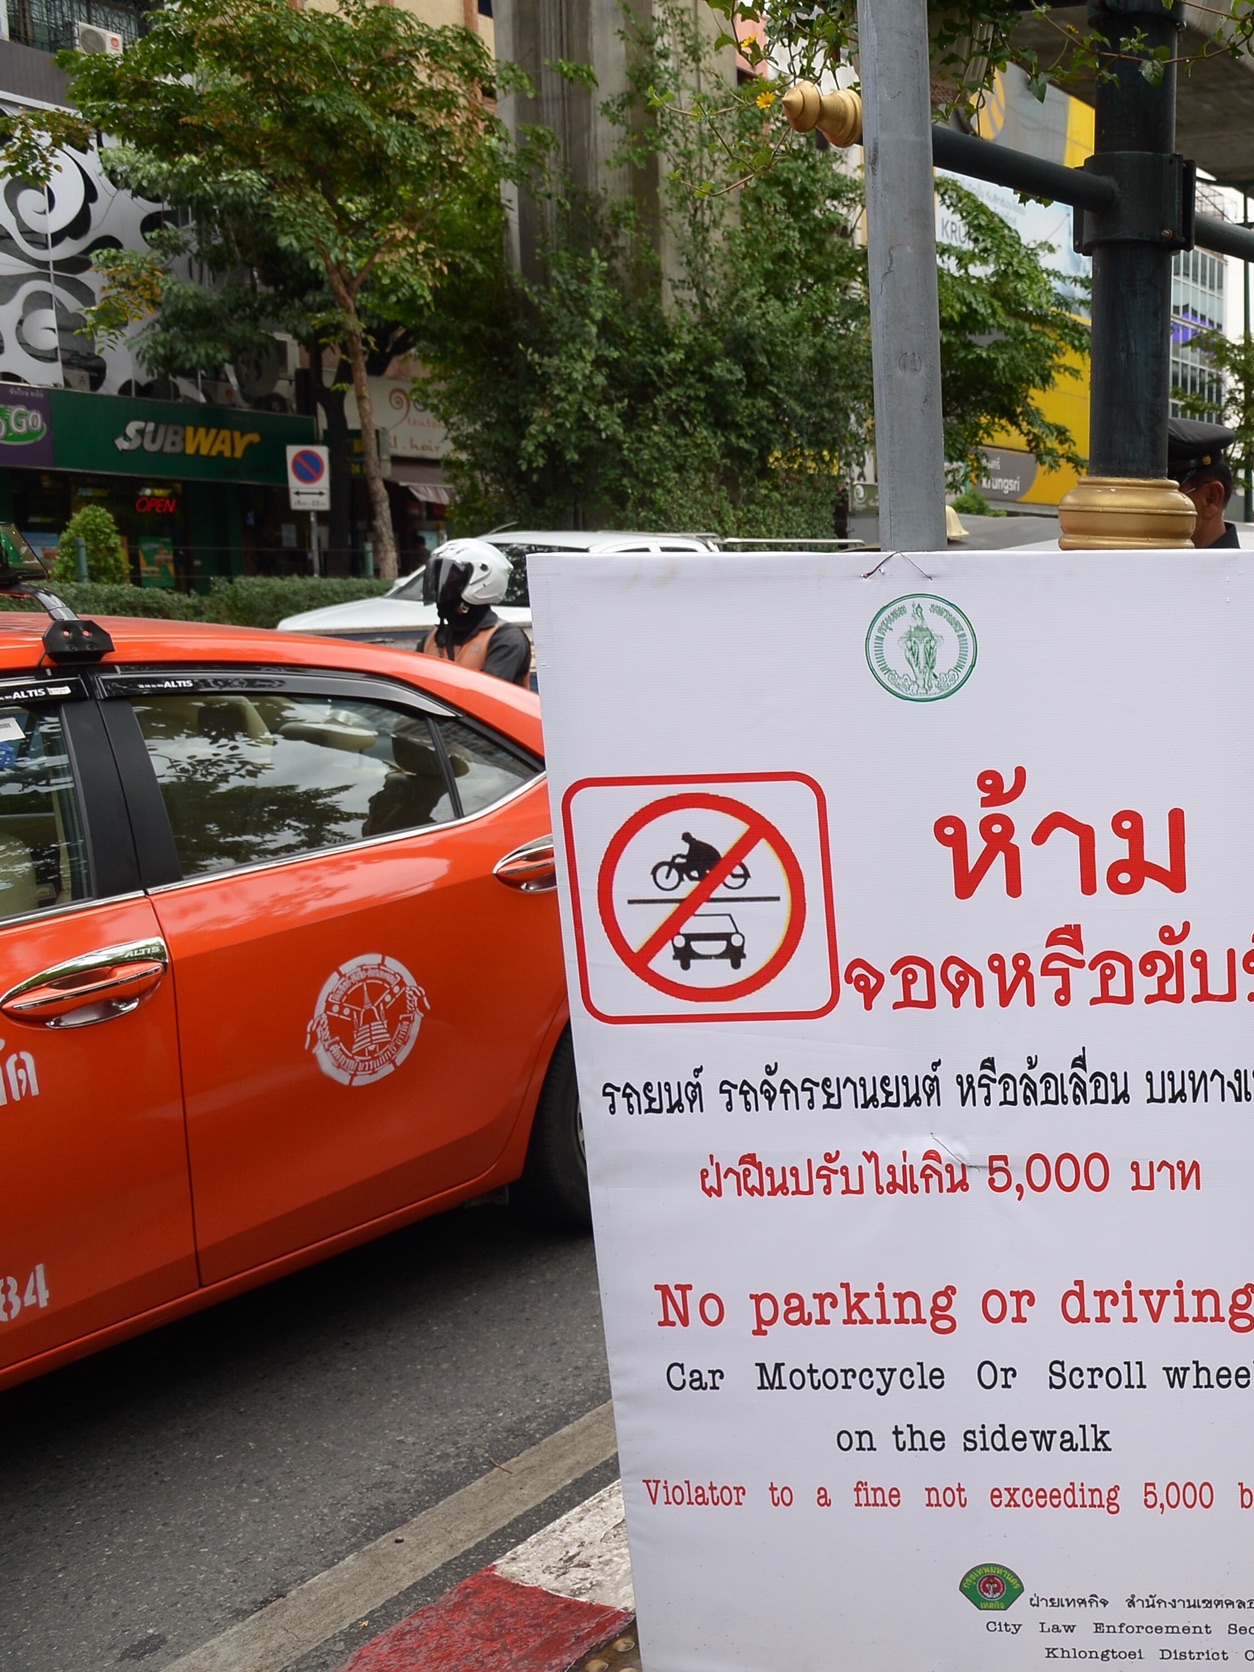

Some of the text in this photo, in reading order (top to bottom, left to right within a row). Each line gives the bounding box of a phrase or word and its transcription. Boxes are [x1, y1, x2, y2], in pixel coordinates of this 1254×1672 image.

[114, 421, 261, 459] SUBWAY
[135, 497, 176, 513] OPEN
[13, 688, 46, 700] ALTIS
[163, 680, 193, 688] ALTIS
[934, 766, 1186, 900] ห้าม
[125, 946, 160, 958] ALTIS
[602, 1065, 704, 1115] รถยนต์
[719, 1058, 942, 1112] รถจักรยานยนต์
[955, 1046, 1131, 1107] หรือล้อเลื่อน
[700, 1149, 1201, 1201] ฝ่าฝืนปรับไม่เกิน 5,000 บาท
[654, 1283, 725, 1327] No
[749, 1282, 957, 1336] parking
[981, 1288, 1036, 1324] or
[666, 1362, 725, 1391] Car
[755, 1362, 945, 1396] Motorcycle
[977, 1360, 1018, 1390] Or
[1048, 1360, 1147, 1390] Scroll
[836, 1423, 1113, 1452] on the sidewalk
[642, 1479, 747, 1506] Violator
[768, 1481, 794, 1507] to
[816, 1486, 832, 1507] a
[853, 1480, 902, 1507] fine
[924, 1482, 968, 1508] not
[989, 1482, 1121, 1515] exceeding
[1142, 1481, 1215, 1515] 5,000
[1029, 1593, 1110, 1609] ฝ่ายเทศกิจ
[986, 1621, 1023, 1636] City
[1039, 1622, 1077, 1634] Law
[1093, 1622, 1212, 1635] Enforcement
[1045, 1647, 1145, 1662] Khlongtoei
[1159, 1648, 1230, 1661] District
